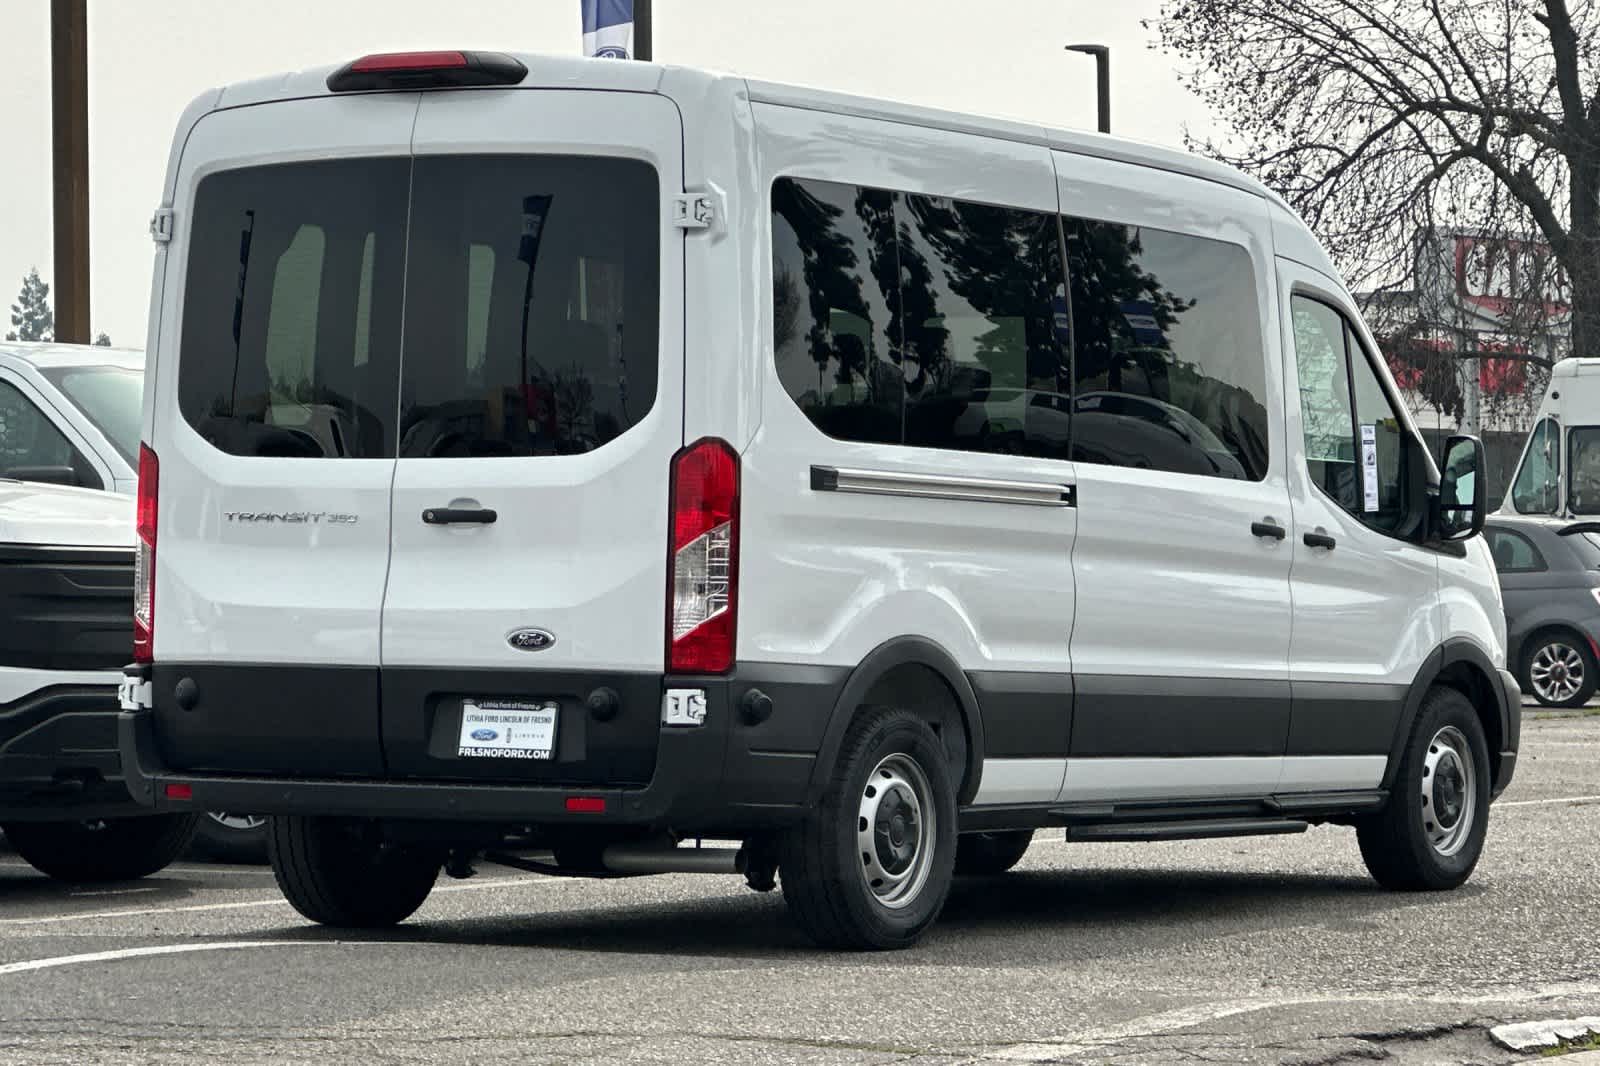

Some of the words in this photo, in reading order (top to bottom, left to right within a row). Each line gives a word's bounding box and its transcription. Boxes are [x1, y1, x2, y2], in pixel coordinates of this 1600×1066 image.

[224, 511, 326, 523] TRANSIT
[327, 514, 359, 524] 350
[516, 632, 544, 646] Ford
[466, 714, 484, 722] LITHIA
[484, 715, 499, 723] FORD
[499, 715, 523, 723] LINCOLN
[523, 716, 531, 724] OF
[531, 716, 552, 724] FRESNO
